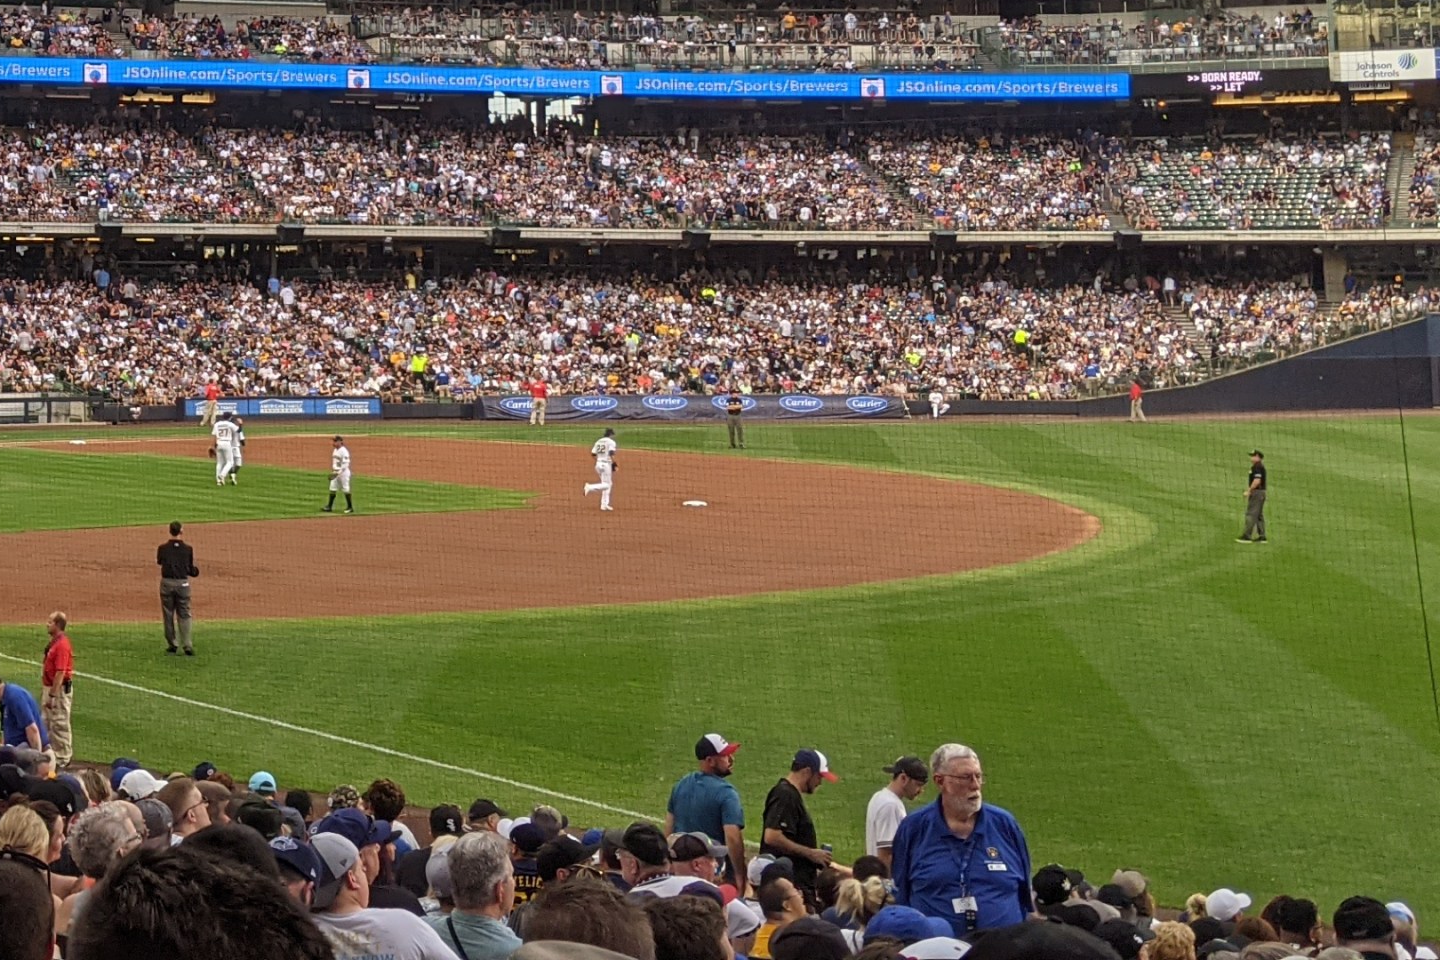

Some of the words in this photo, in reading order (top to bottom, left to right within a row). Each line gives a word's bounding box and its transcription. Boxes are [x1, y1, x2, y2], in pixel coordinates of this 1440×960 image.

[1356, 62, 1392, 71] Johnson
[122, 66, 337, 83] JSOnline.com/Sports/Brewers
[1201, 72, 1227, 82] BORN
[1229, 71, 1263, 81] READY.
[1363, 70, 1400, 78] Controls
[384, 72, 590, 90] JSOnline.com/Sports/Brewers
[635, 77, 849, 94] JSOnline.com/Sports/Brewers
[896, 81, 1119, 96] JSOnline.com/Sports/Brewers
[578, 399, 611, 408] Carrier
[648, 396, 681, 405] Carrier
[785, 398, 817, 407] Carrier
[852, 399, 883, 408] Carrier
[218, 428, 229, 437] 27
[597, 444, 606, 454] 22
